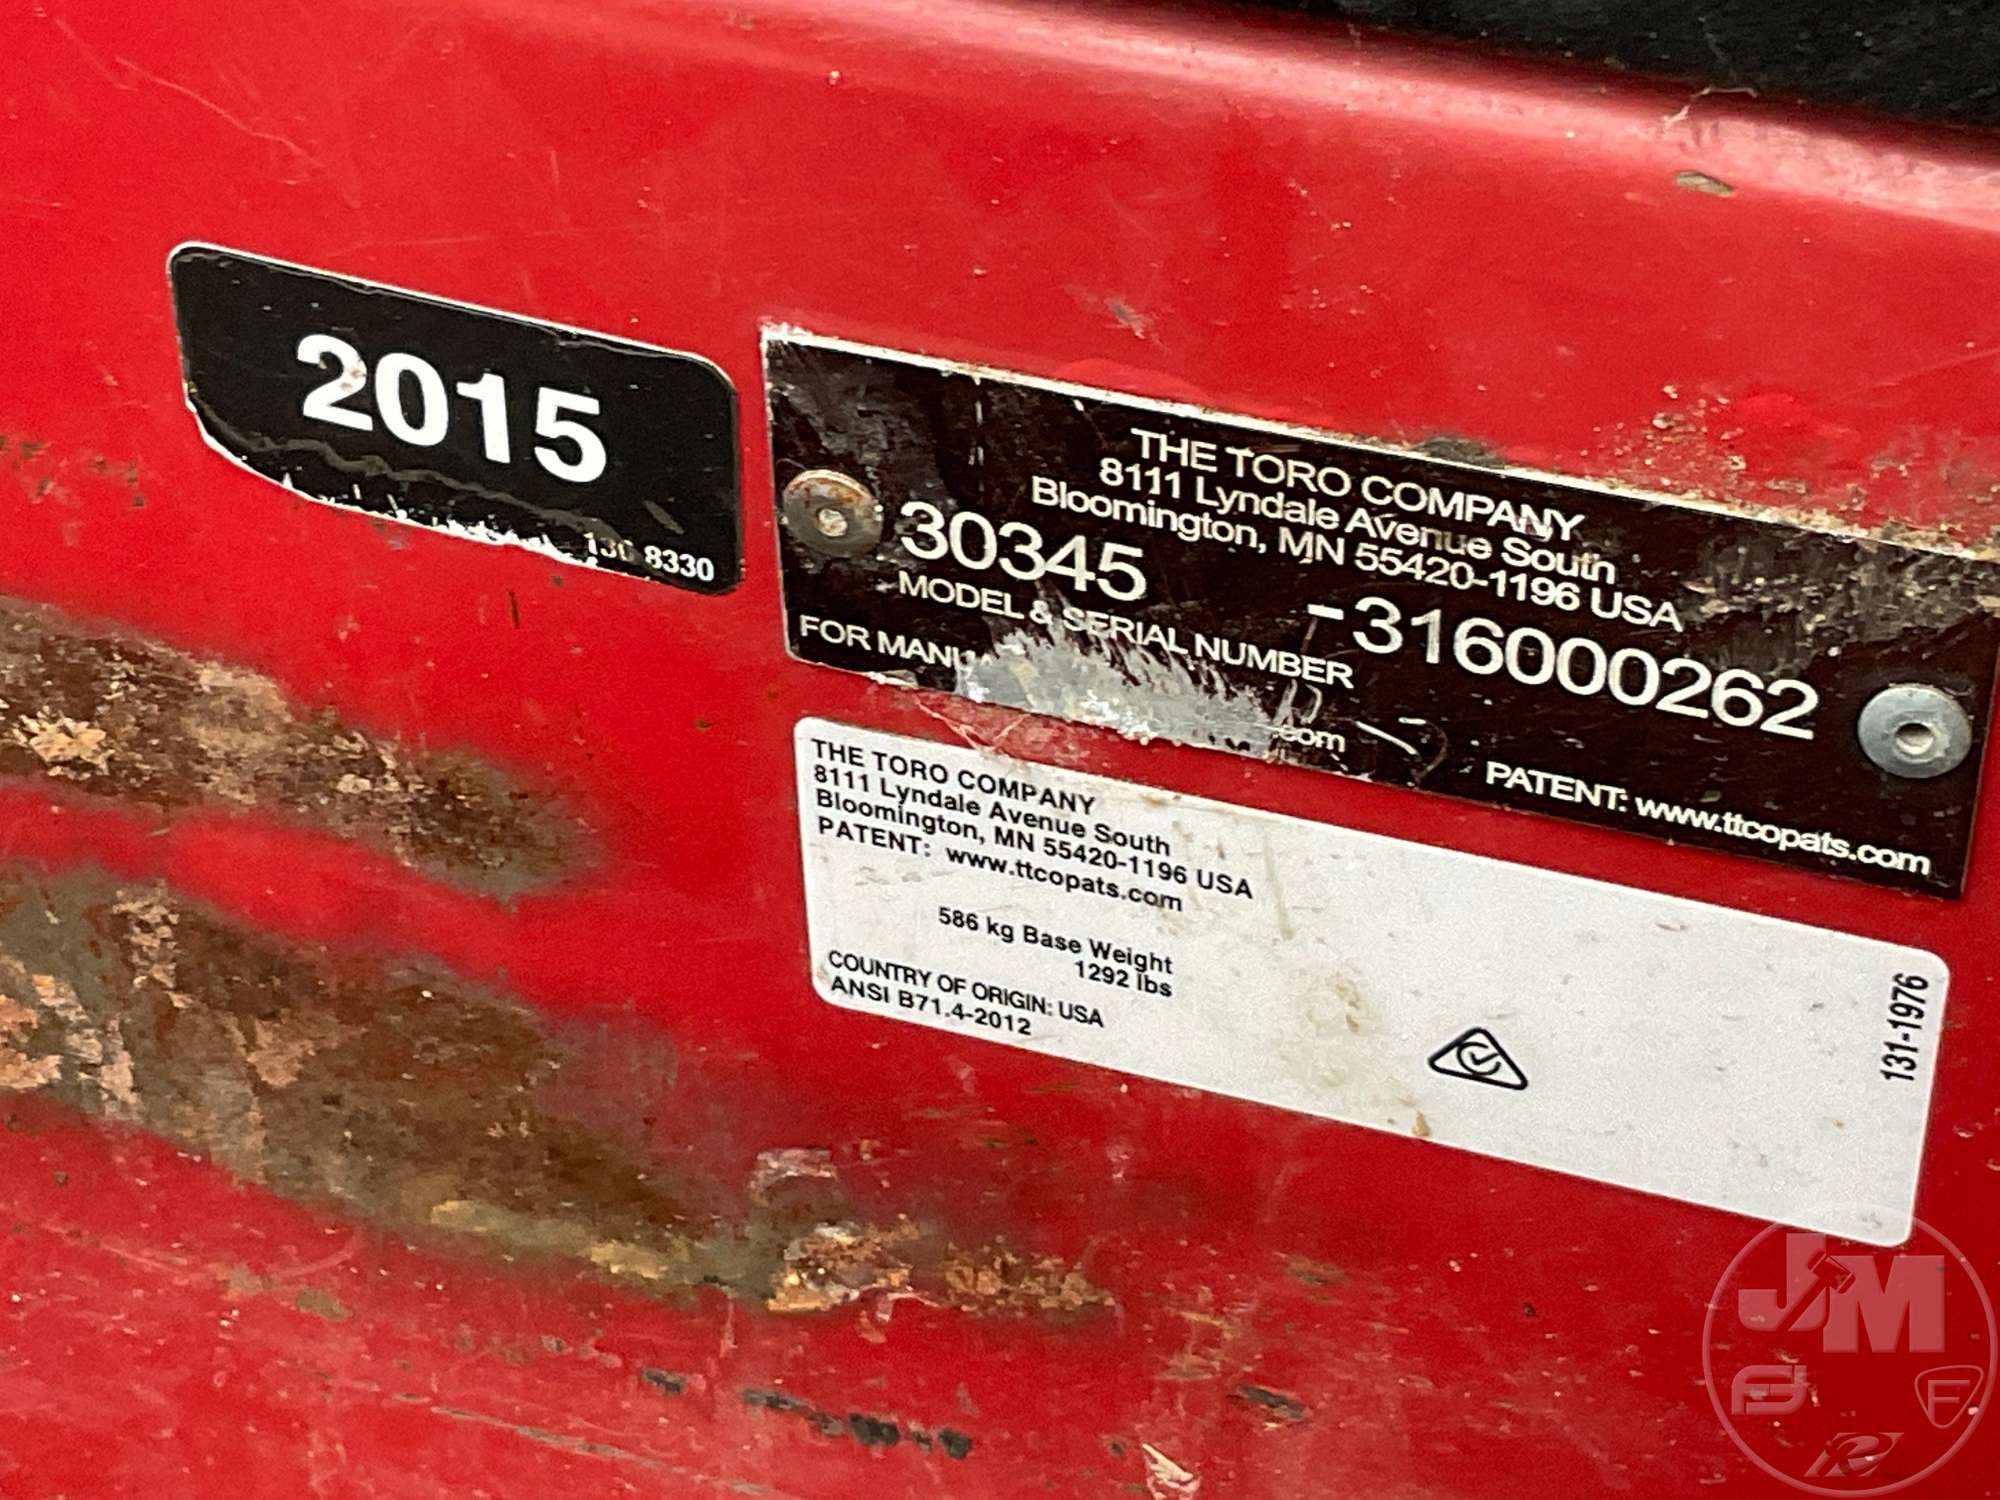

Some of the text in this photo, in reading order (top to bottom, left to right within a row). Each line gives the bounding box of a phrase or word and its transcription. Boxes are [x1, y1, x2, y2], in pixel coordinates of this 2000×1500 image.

[297, 334, 607, 483] 2015
[1101, 457, 1615, 584] 8111 Lyndale Avenue South
[1131, 428, 1585, 542] THE TORO COMPANY
[901, 501, 1147, 602] 30345
[1032, 476, 1685, 633] Bloomington, MN 55420-1196 USA
[800, 615, 871, 650] FOR
[899, 571, 1354, 689] MODEL & SERIAL NUMBER
[812, 739, 1096, 815] THE TORO COMPANY
[814, 765, 1171, 857] 8111 Lyndale Avenue South
[1486, 761, 1930, 875] PATENT: www.ttcopats.com
[817, 789, 1254, 900] Bloomington, MN 55420-1196 USA
[818, 817, 1184, 912] PATENT: www.ttcopats.com
[828, 949, 1105, 1029] COUNTRY OF ORIGIN: USA
[938, 906, 1173, 975] 586 kg Base Weight
[1075, 960, 1173, 998] 1292 lbs
[830, 975, 1033, 1036] ANSI B71.4-2012
[1879, 973, 1930, 1082] 131-1976
